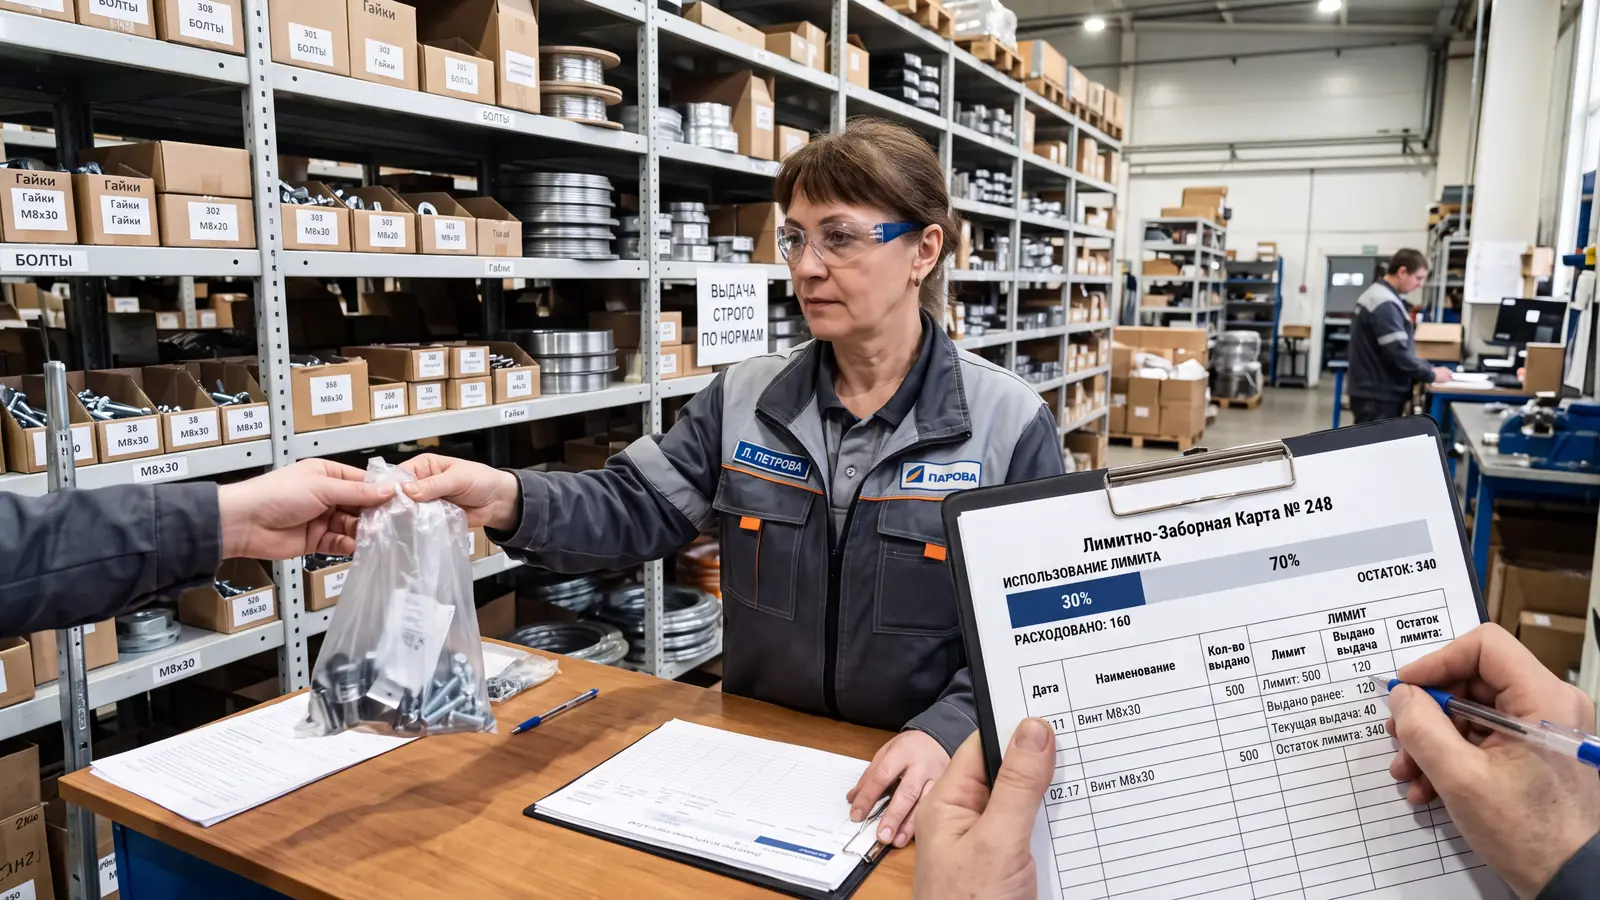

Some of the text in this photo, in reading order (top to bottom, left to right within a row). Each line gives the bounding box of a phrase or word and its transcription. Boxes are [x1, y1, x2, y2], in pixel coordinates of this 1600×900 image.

[198, 3, 213, 13] 308
[363, 0, 395, 20] Гайки
[189, 18, 224, 34] БОЛТЫ
[304, 29, 317, 39] 301
[297, 43, 327, 57] БОЛТЫ
[379, 45, 391, 55] 302
[375, 58, 395, 70] Гайки
[483, 111, 510, 124] БОЛТЫ
[16, 173, 56, 187] Гайки
[104, 180, 141, 192] Гайки
[22, 192, 55, 203] Гайки
[111, 199, 140, 210] Гайки
[21, 209, 58, 220] M8x30
[206, 207, 220, 215] 302
[311, 214, 323, 222] 303
[111, 215, 141, 225] Гайки
[200, 221, 228, 231] M8x20
[305, 227, 330, 236] M8x30
[15, 254, 73, 267] БОЛТЫ
[711, 283, 757, 300] ВЫДАЧА
[713, 306, 754, 322] СТРОГО
[701, 328, 764, 347] ПО НОРМАМ
[320, 393, 344, 403] M8x30
[188, 416, 199, 424] 38
[243, 410, 254, 419] 98
[127, 424, 138, 433] 38
[180, 427, 209, 438] M8x30
[236, 421, 263, 432] M8x30
[117, 435, 149, 448] M8x30
[741, 447, 802, 473] Л. ПЕТРОВА
[140, 461, 179, 477] M8x30
[928, 471, 977, 483] ПАРОВА
[1083, 496, 1333, 553] Лимитно-Заборная Карта № 248
[1003, 550, 1162, 589] ИСПОЛЬЗОВАНИЕ ЛИМИТА
[1269, 553, 1301, 571] 70%
[1356, 558, 1437, 583] ОСТАТОК: 340
[1061, 591, 1093, 609] 30%
[241, 604, 267, 618] M8x30
[1327, 607, 1367, 625] ЛИМИТ
[1396, 614, 1439, 630] Остаток
[1014, 615, 1131, 646] РАСХОДОВАНО: 160
[1332, 627, 1375, 643] Выдано
[1400, 628, 1443, 645] лимита:
[1207, 642, 1246, 657] Кол-во
[1271, 646, 1307, 661] Лимит
[1336, 641, 1378, 657] выдача
[159, 658, 196, 678] M8x30
[1208, 654, 1250, 671] выдано
[1352, 660, 1371, 674] 120
[1095, 662, 1176, 685] Наименование
[1262, 669, 1321, 691] Лимит: 500
[1032, 683, 1059, 698] Дата
[1225, 683, 1245, 697] 500
[1266, 681, 1376, 713] Выдано ранее: 120
[1077, 703, 1141, 726] Винт M8x30
[1272, 704, 1377, 735] Текущая выдача: 40
[1276, 724, 1385, 755] Остаток лимита: 340
[1239, 749, 1259, 763] 500
[1090, 769, 1155, 793] Винт M8x30
[1050, 784, 1080, 801] 02.17
